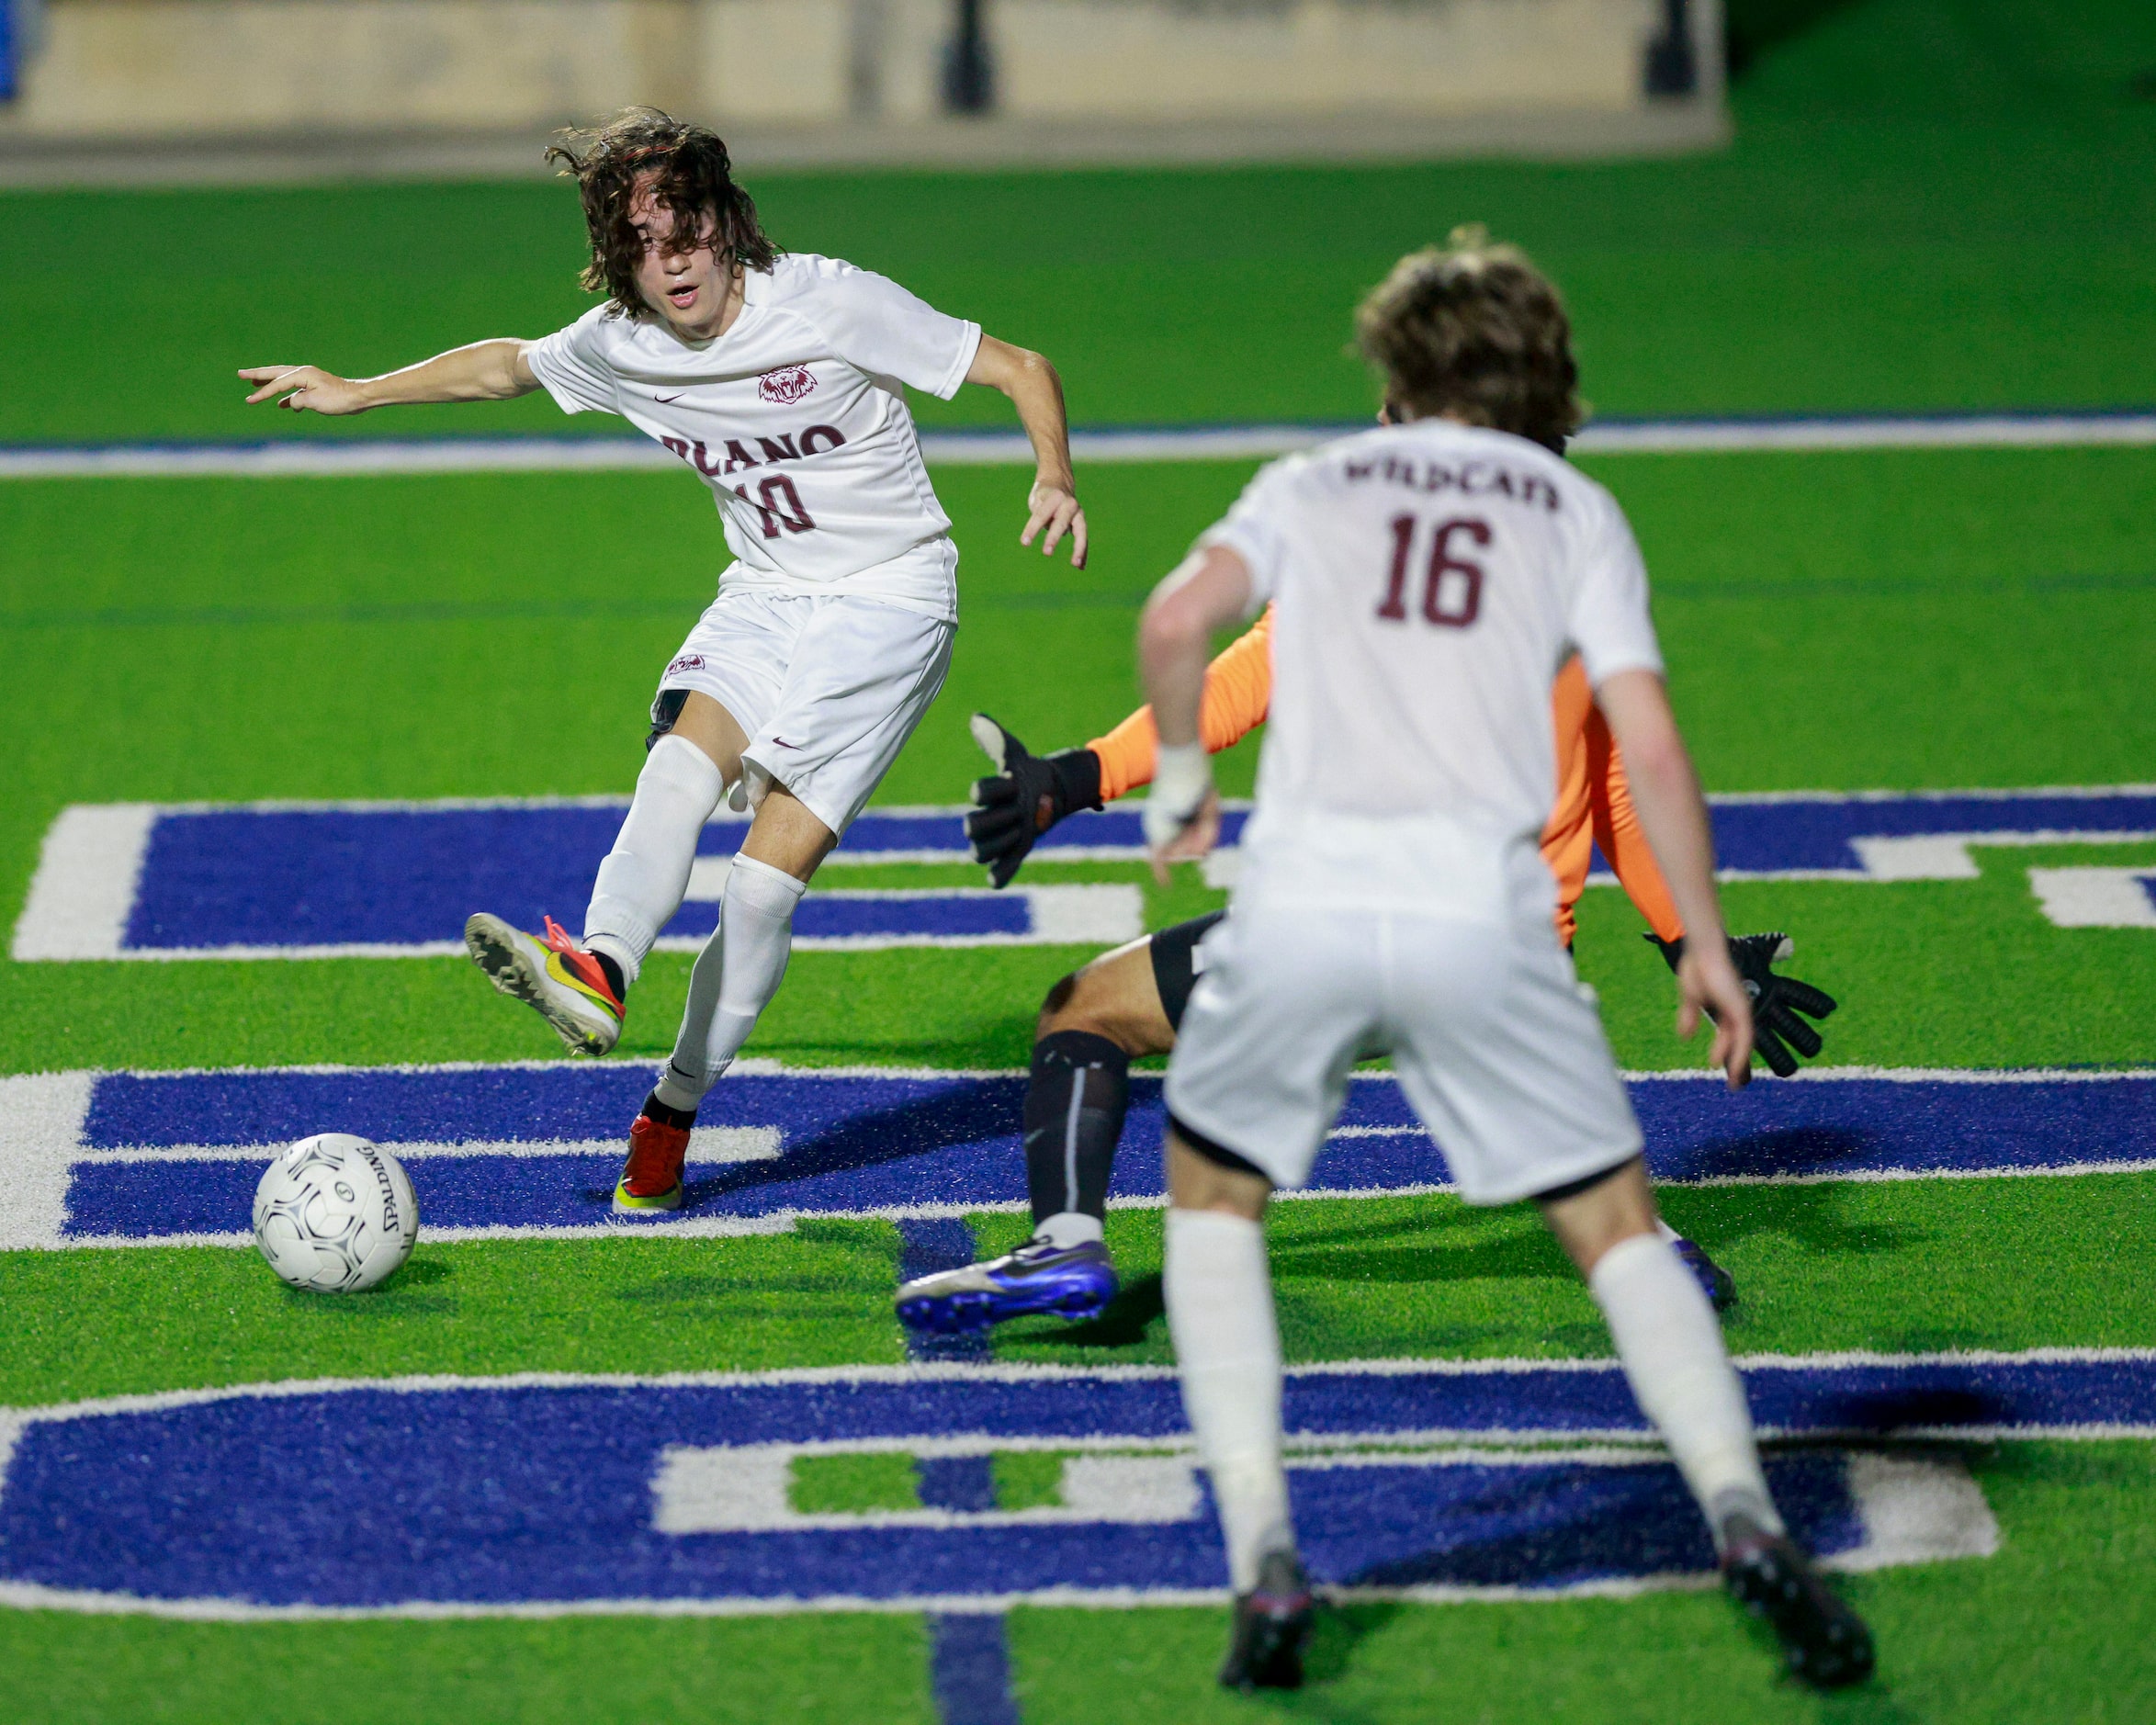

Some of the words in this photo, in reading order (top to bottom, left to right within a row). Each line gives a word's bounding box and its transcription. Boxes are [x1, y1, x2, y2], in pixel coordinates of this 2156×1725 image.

[735, 473, 816, 540] 10
[1375, 513, 1493, 628] 16
[356, 1145, 400, 1233] SPALDING
